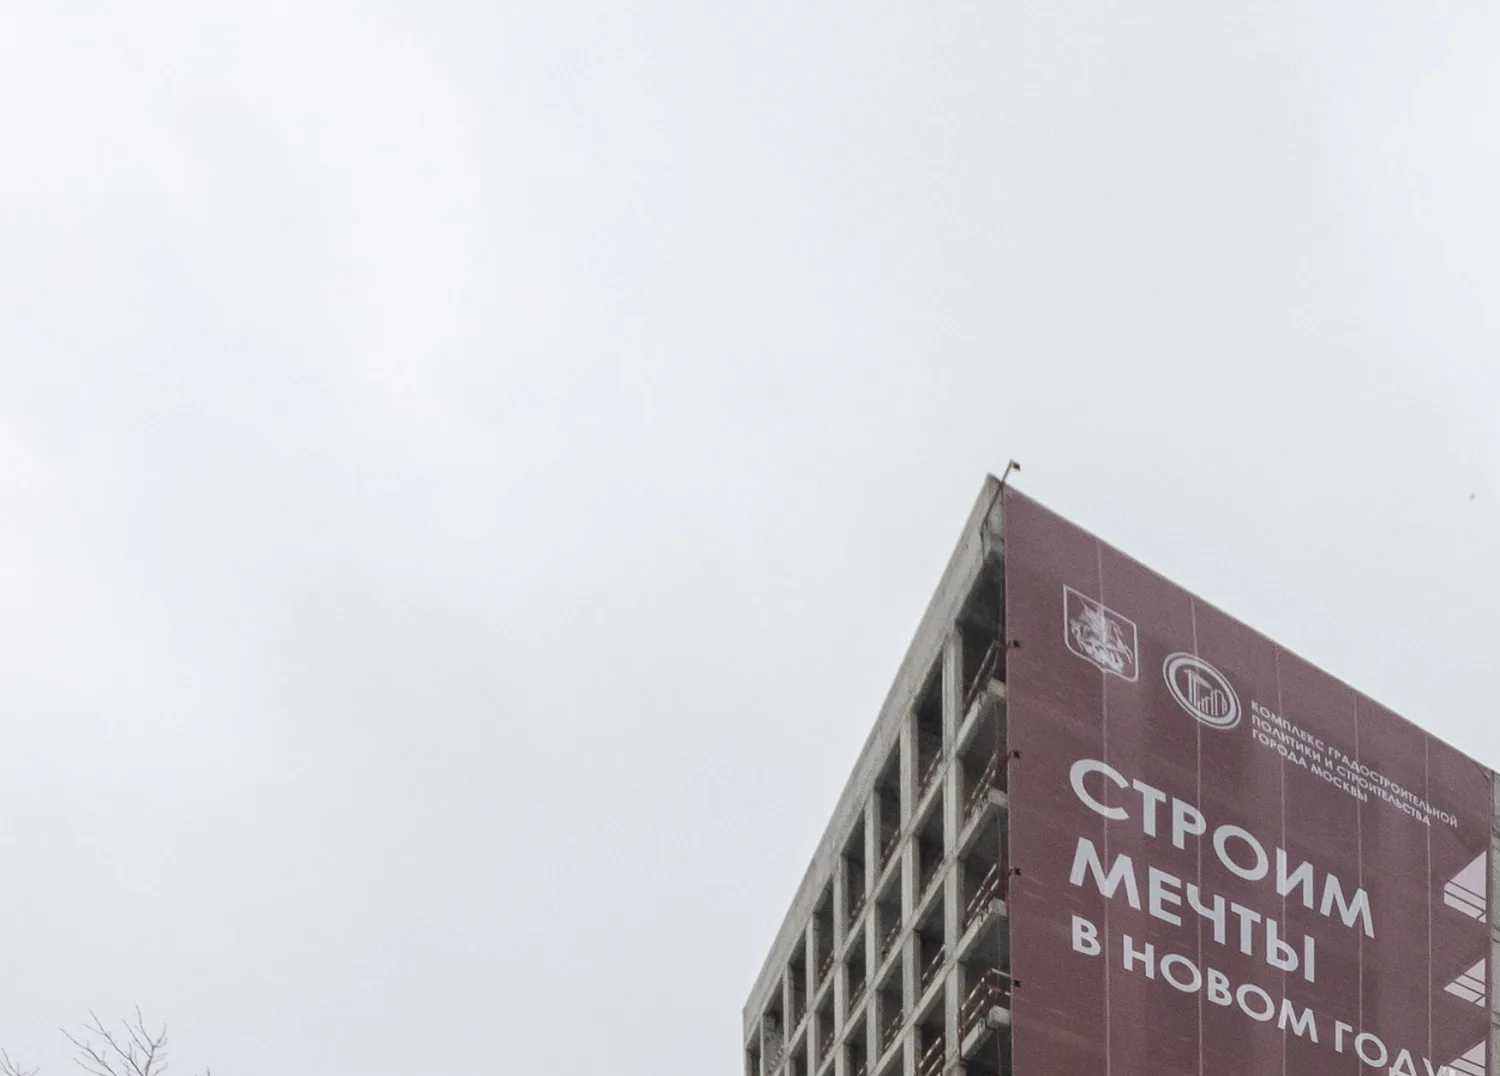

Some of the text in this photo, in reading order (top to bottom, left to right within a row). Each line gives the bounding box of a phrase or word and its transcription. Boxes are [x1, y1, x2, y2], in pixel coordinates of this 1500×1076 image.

[1251, 700, 1458, 828] КОМПЛЕКС ГРАДОСТРОИТЕЛЬНОЙ
[1251, 714, 1431, 826] ПОЛИТИКИ И СТРОИТЕЛЬСТВА
[1252, 728, 1368, 802] ГОРОДА МОСКВЫ
[1069, 759, 1375, 939] СТРОИМ
[1069, 837, 1315, 983] МЕЧТЫ
[1071, 914, 1101, 956] В
[1122, 934, 1319, 1043] НОВОМ
